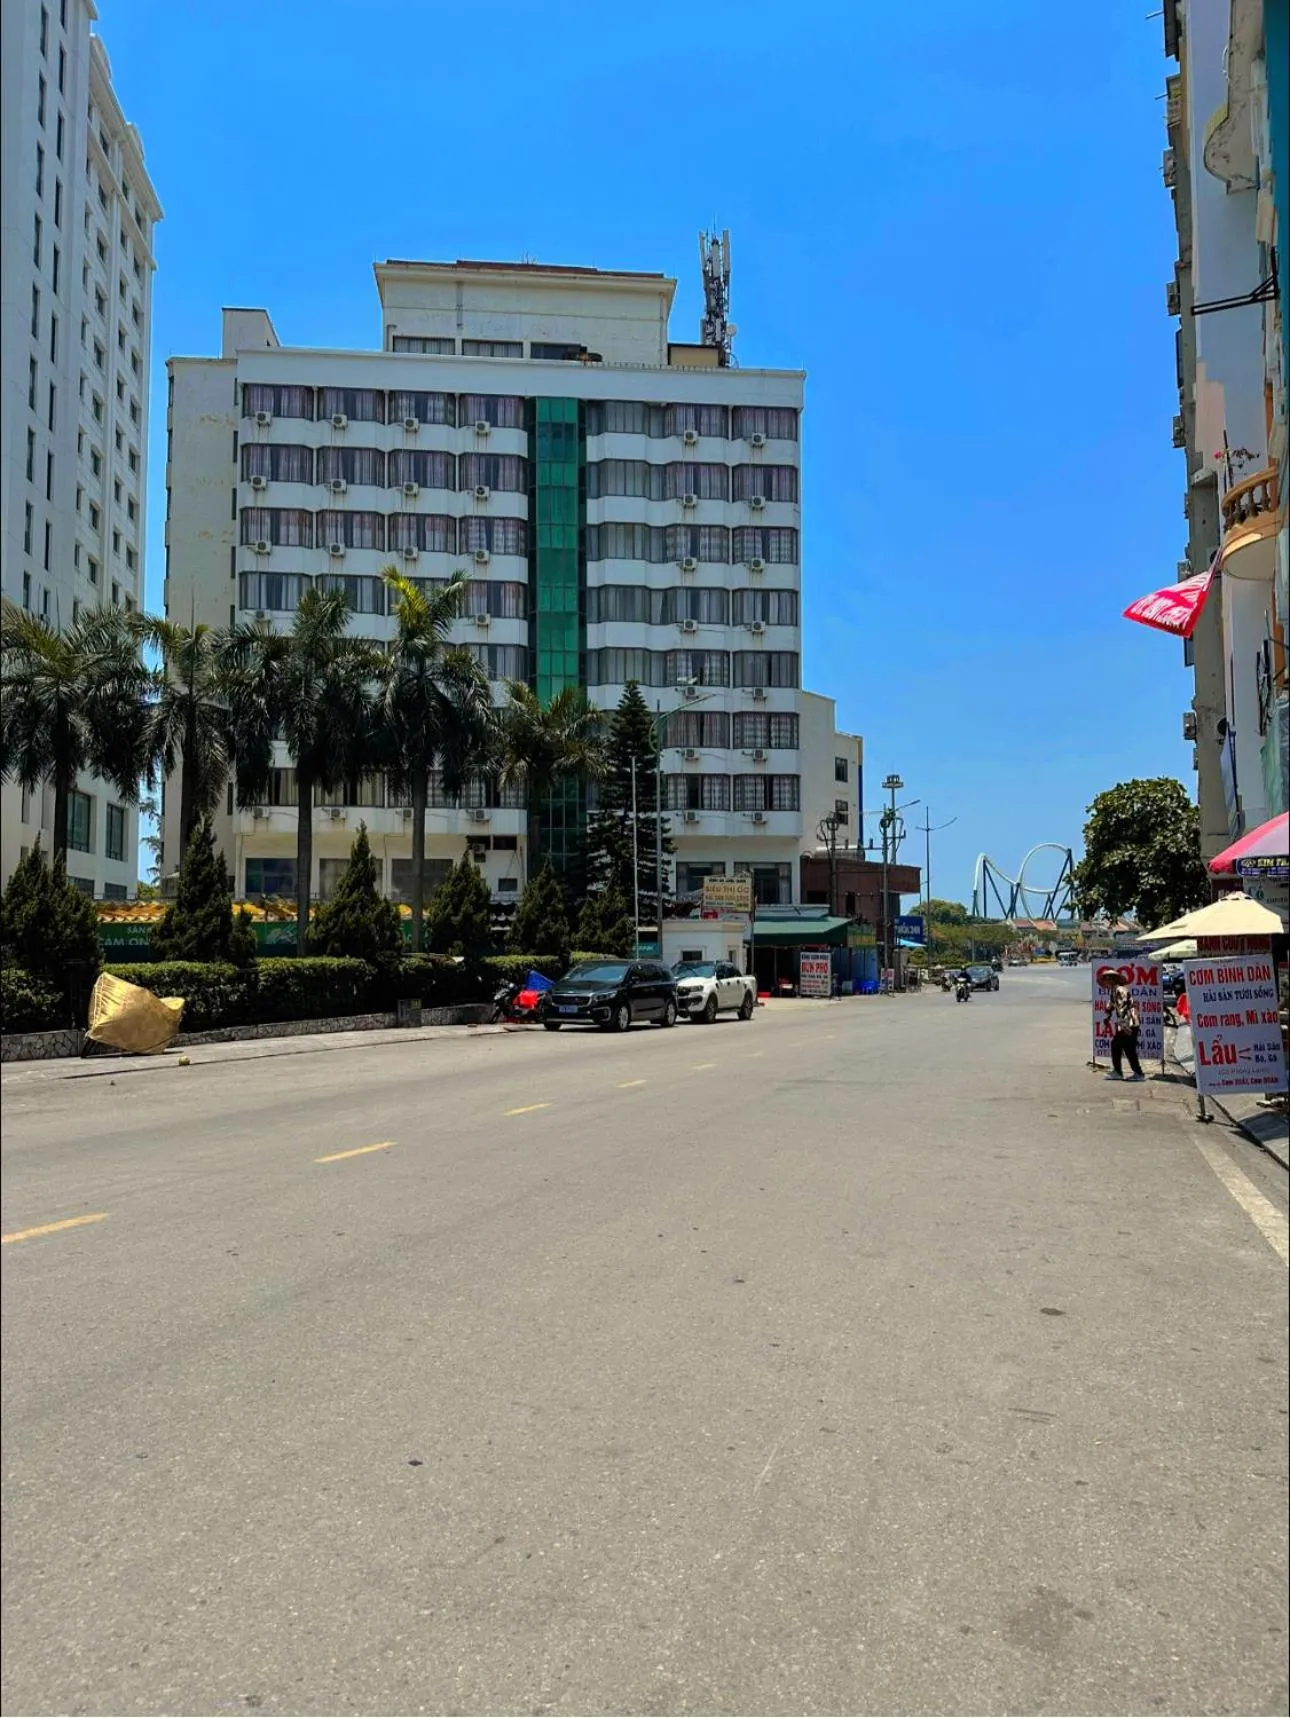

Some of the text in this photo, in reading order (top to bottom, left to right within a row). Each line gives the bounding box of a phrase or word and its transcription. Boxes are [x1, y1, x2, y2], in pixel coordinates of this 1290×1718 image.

[1189, 968, 1214, 985] CƠM
[1247, 963, 1271, 981] DÂN
[1254, 985, 1274, 998] SỐNG
[1198, 1034, 1237, 1066] Lẩu
